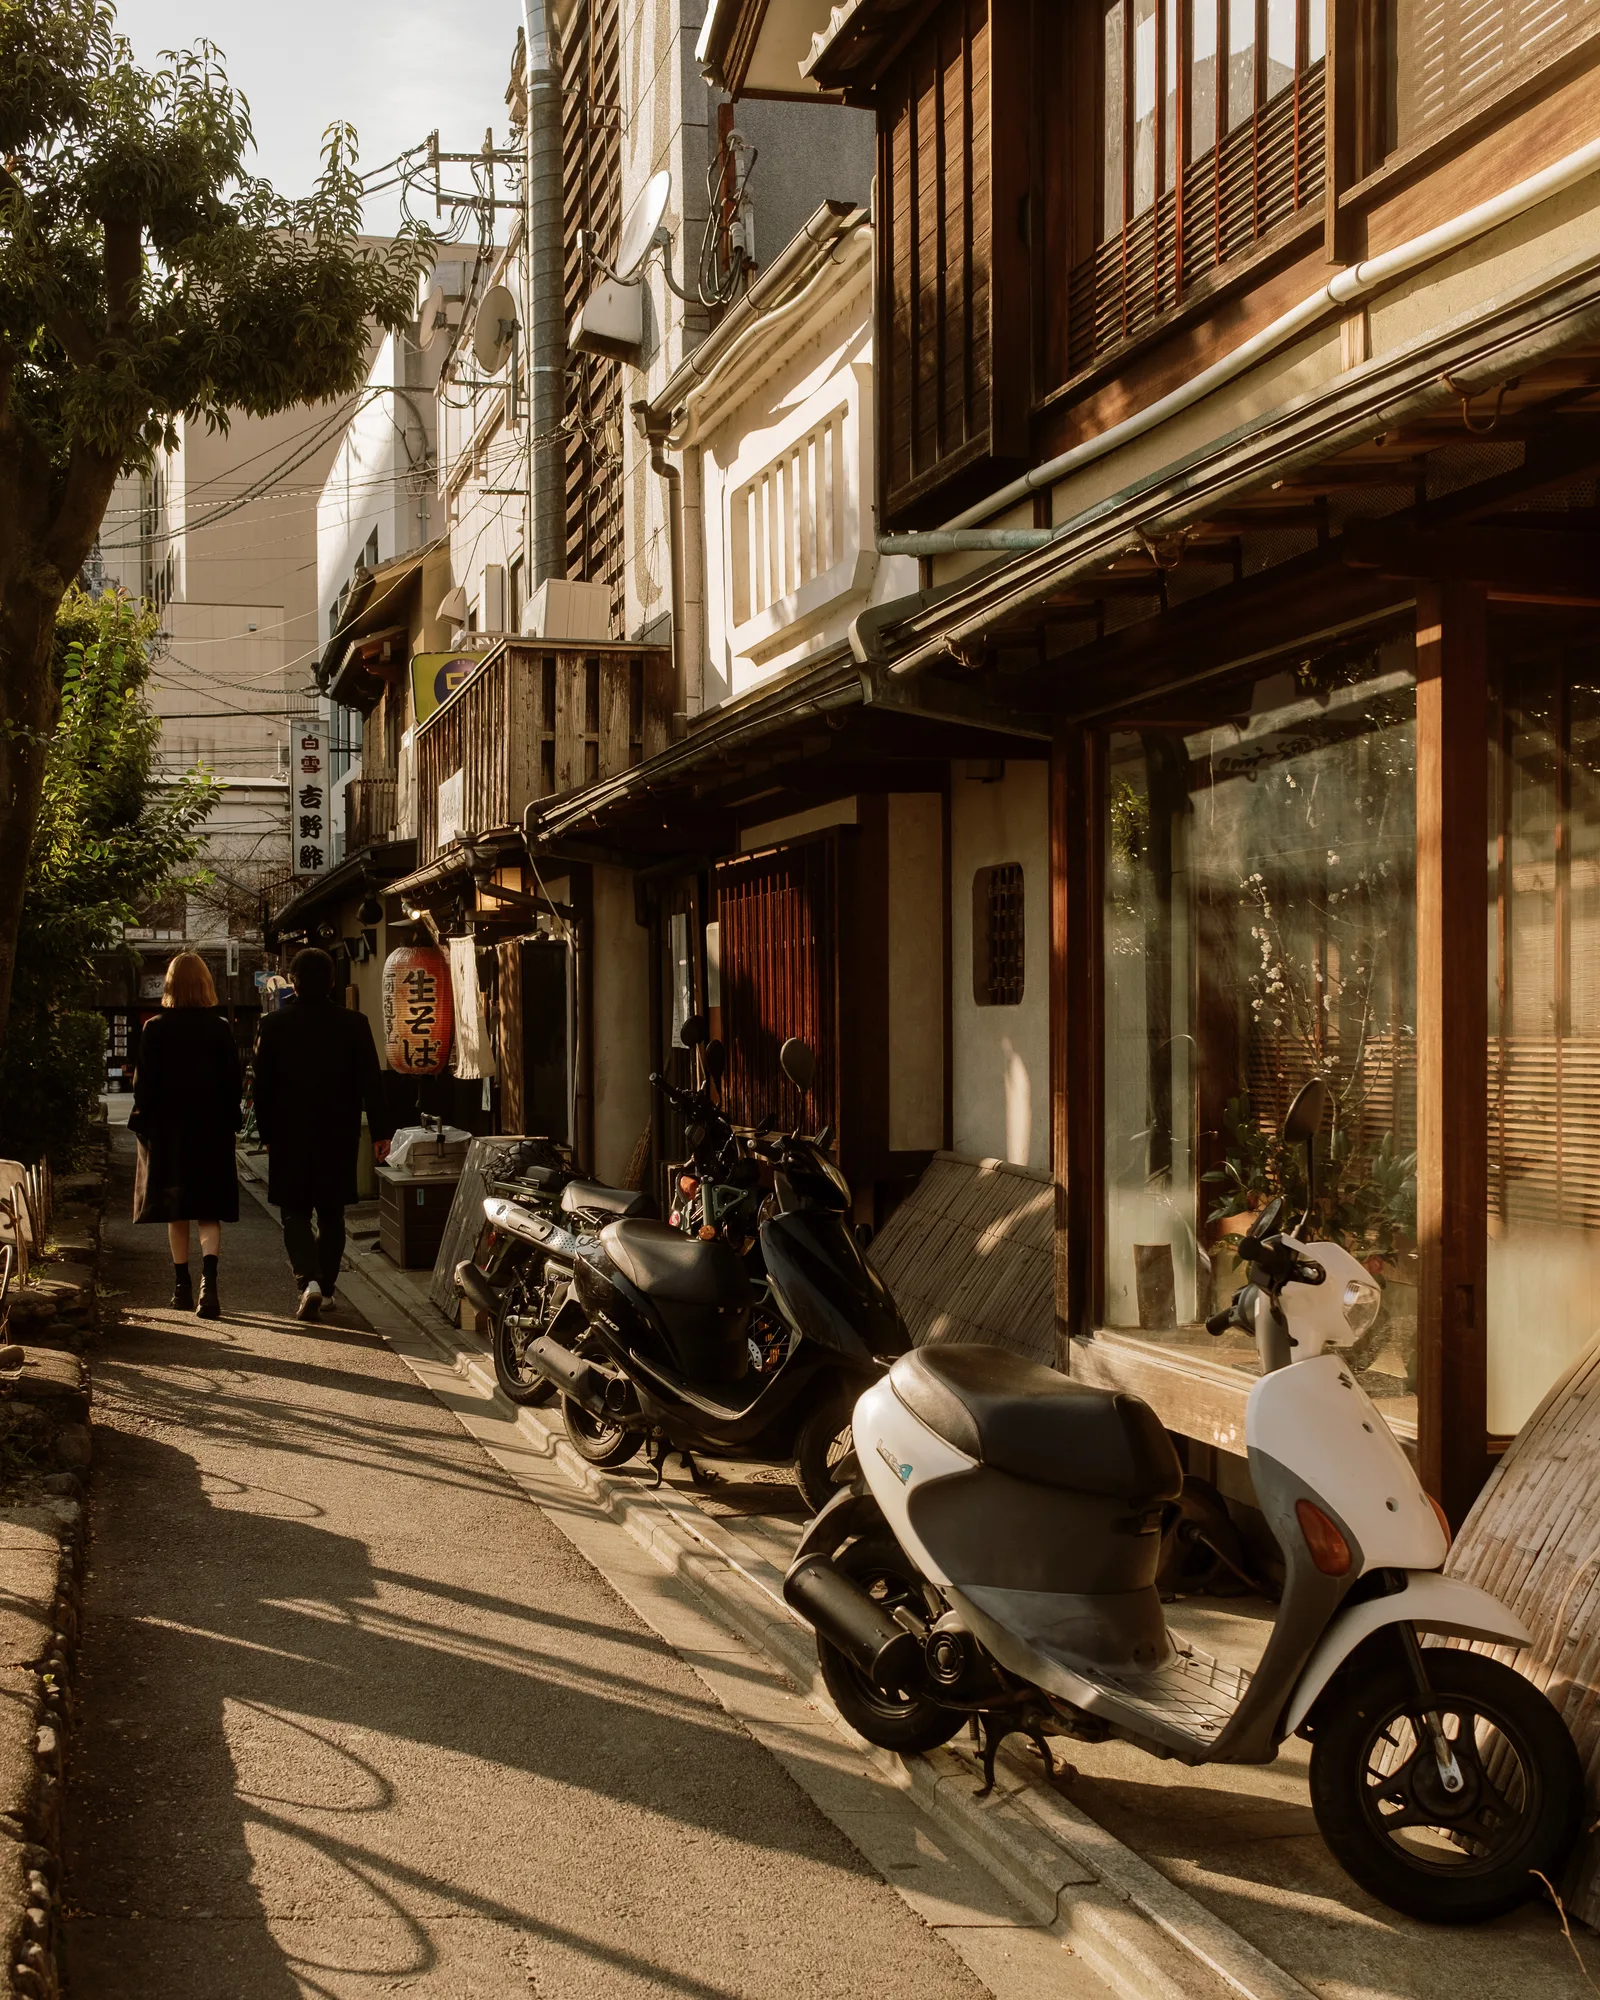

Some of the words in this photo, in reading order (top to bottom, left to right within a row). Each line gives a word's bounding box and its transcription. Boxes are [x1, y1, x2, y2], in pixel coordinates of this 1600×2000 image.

[301, 734, 322, 774] 白雪
[402, 970, 441, 1067] 生そば
